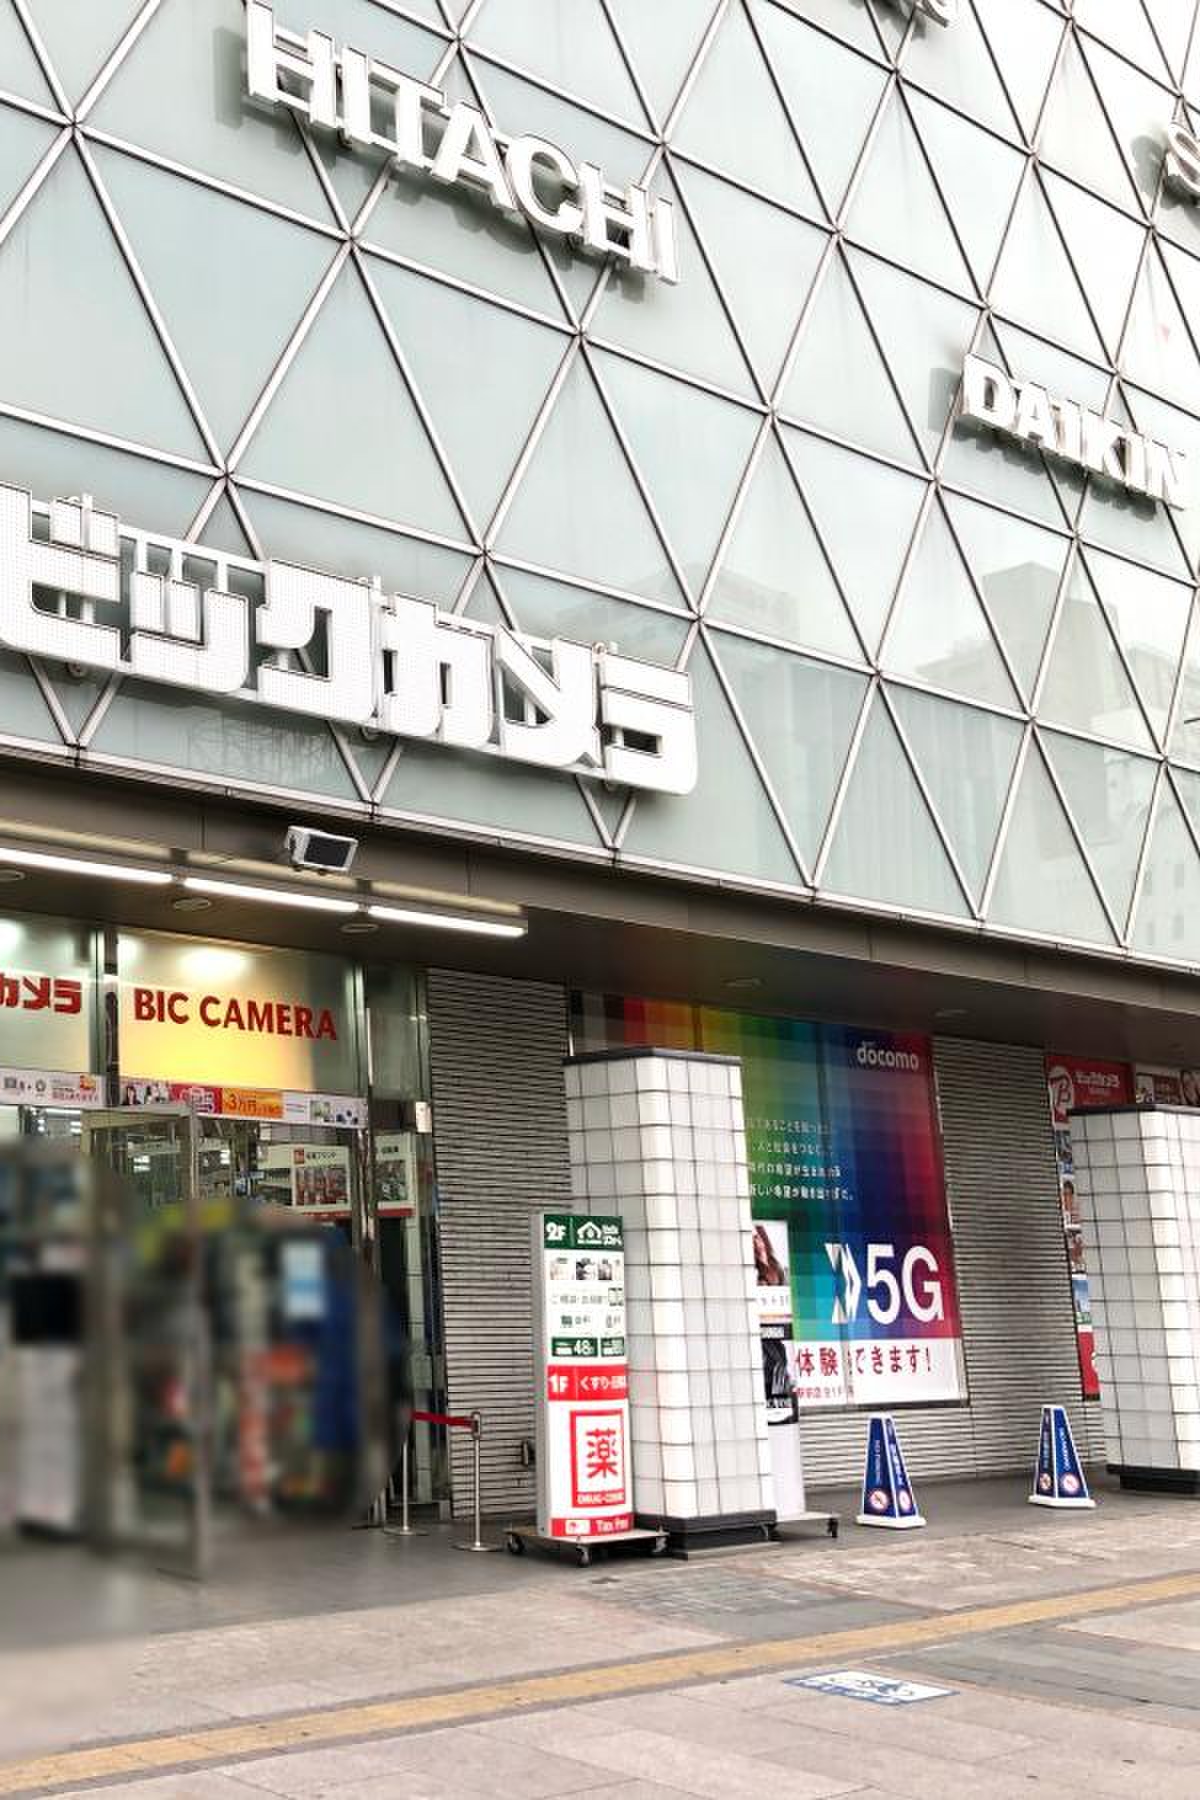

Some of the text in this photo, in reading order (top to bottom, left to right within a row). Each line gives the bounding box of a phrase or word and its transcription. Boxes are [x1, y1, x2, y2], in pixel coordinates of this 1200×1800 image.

[245, 0, 679, 285] HITACHI
[960, 352, 1190, 511] DAIKIN
[133, 987, 337, 1041] BIC CAMERA
[856, 1041, 920, 1071] docomo
[866, 1243, 945, 1325] 5G
[550, 1374, 568, 1393] 1F
[586, 1428, 619, 1479] 薬
